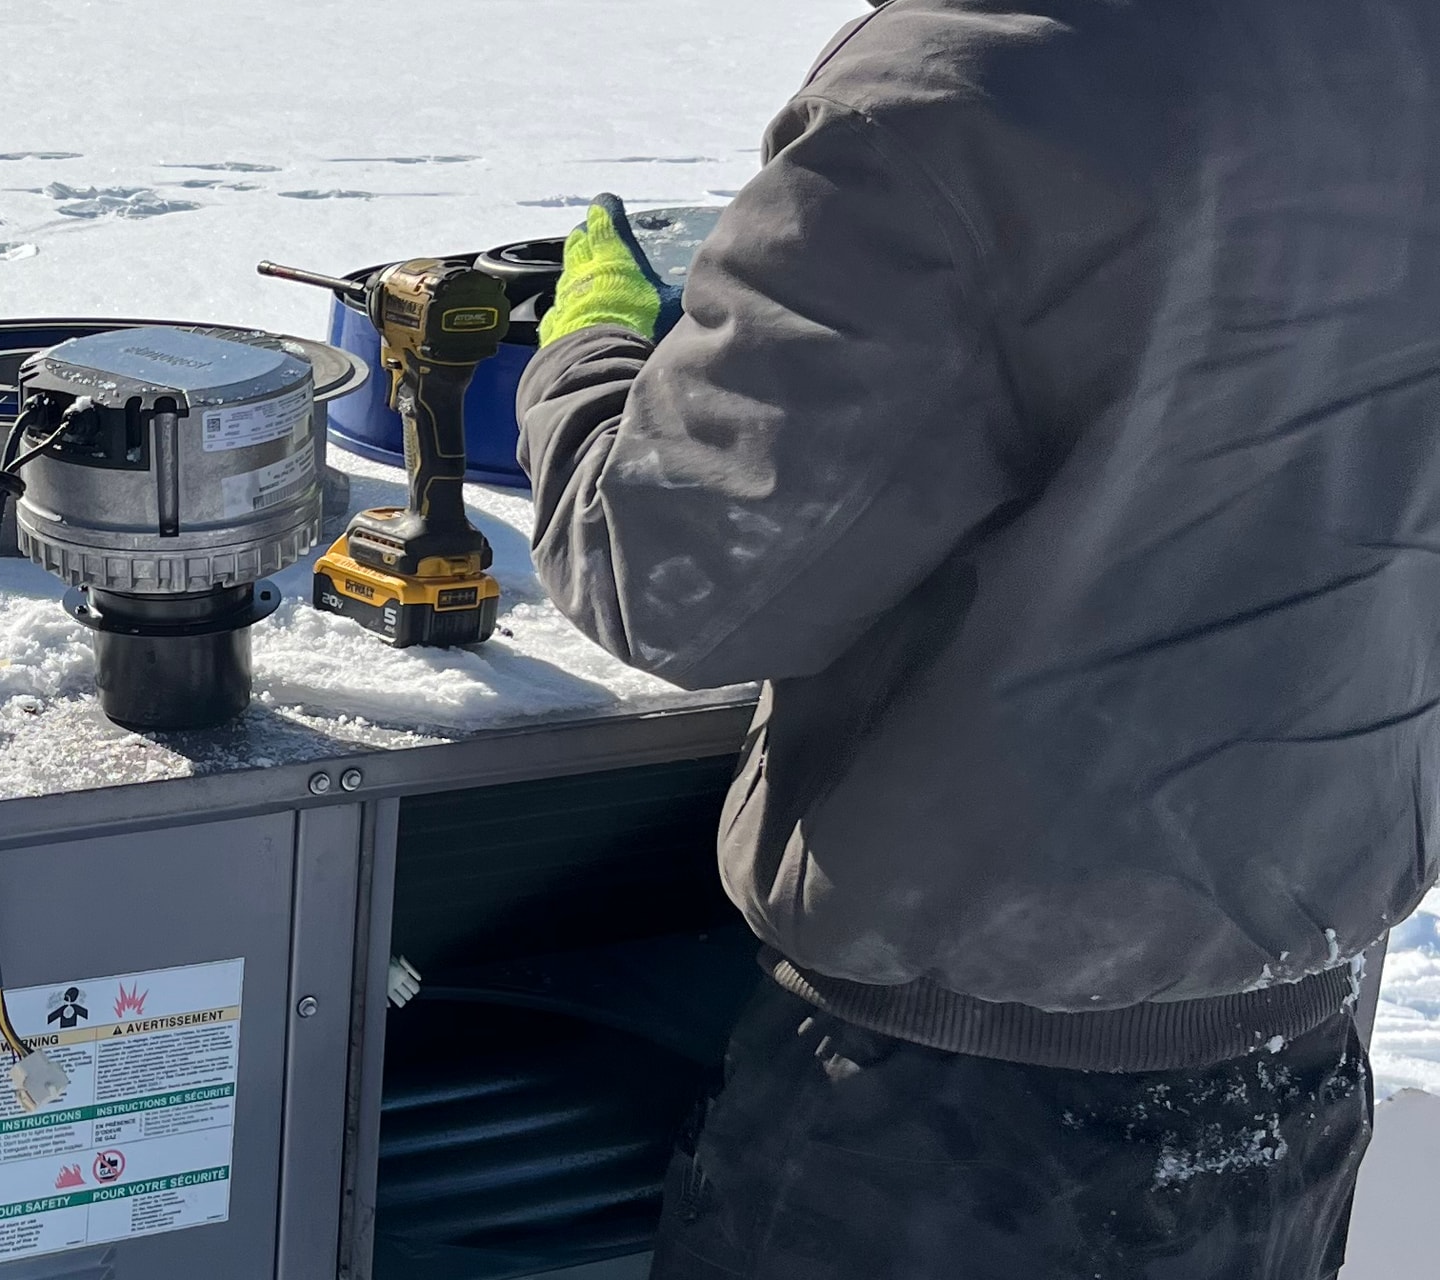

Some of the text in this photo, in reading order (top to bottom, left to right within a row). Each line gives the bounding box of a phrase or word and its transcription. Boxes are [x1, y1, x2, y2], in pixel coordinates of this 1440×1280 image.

[454, 313, 487, 321] ATOMIC
[383, 608, 396, 626] 5
[127, 1010, 224, 1034] AVERTISSEMENT
[97, 1086, 231, 1116] INSTRUCTIONS DE SÉCURITÉ
[2, 1110, 81, 1131] INSTRUCTIONS
[93, 1169, 225, 1201] POUR VOTRE SÉCURITÉ
[26, 1196, 71, 1214] SAFETY
